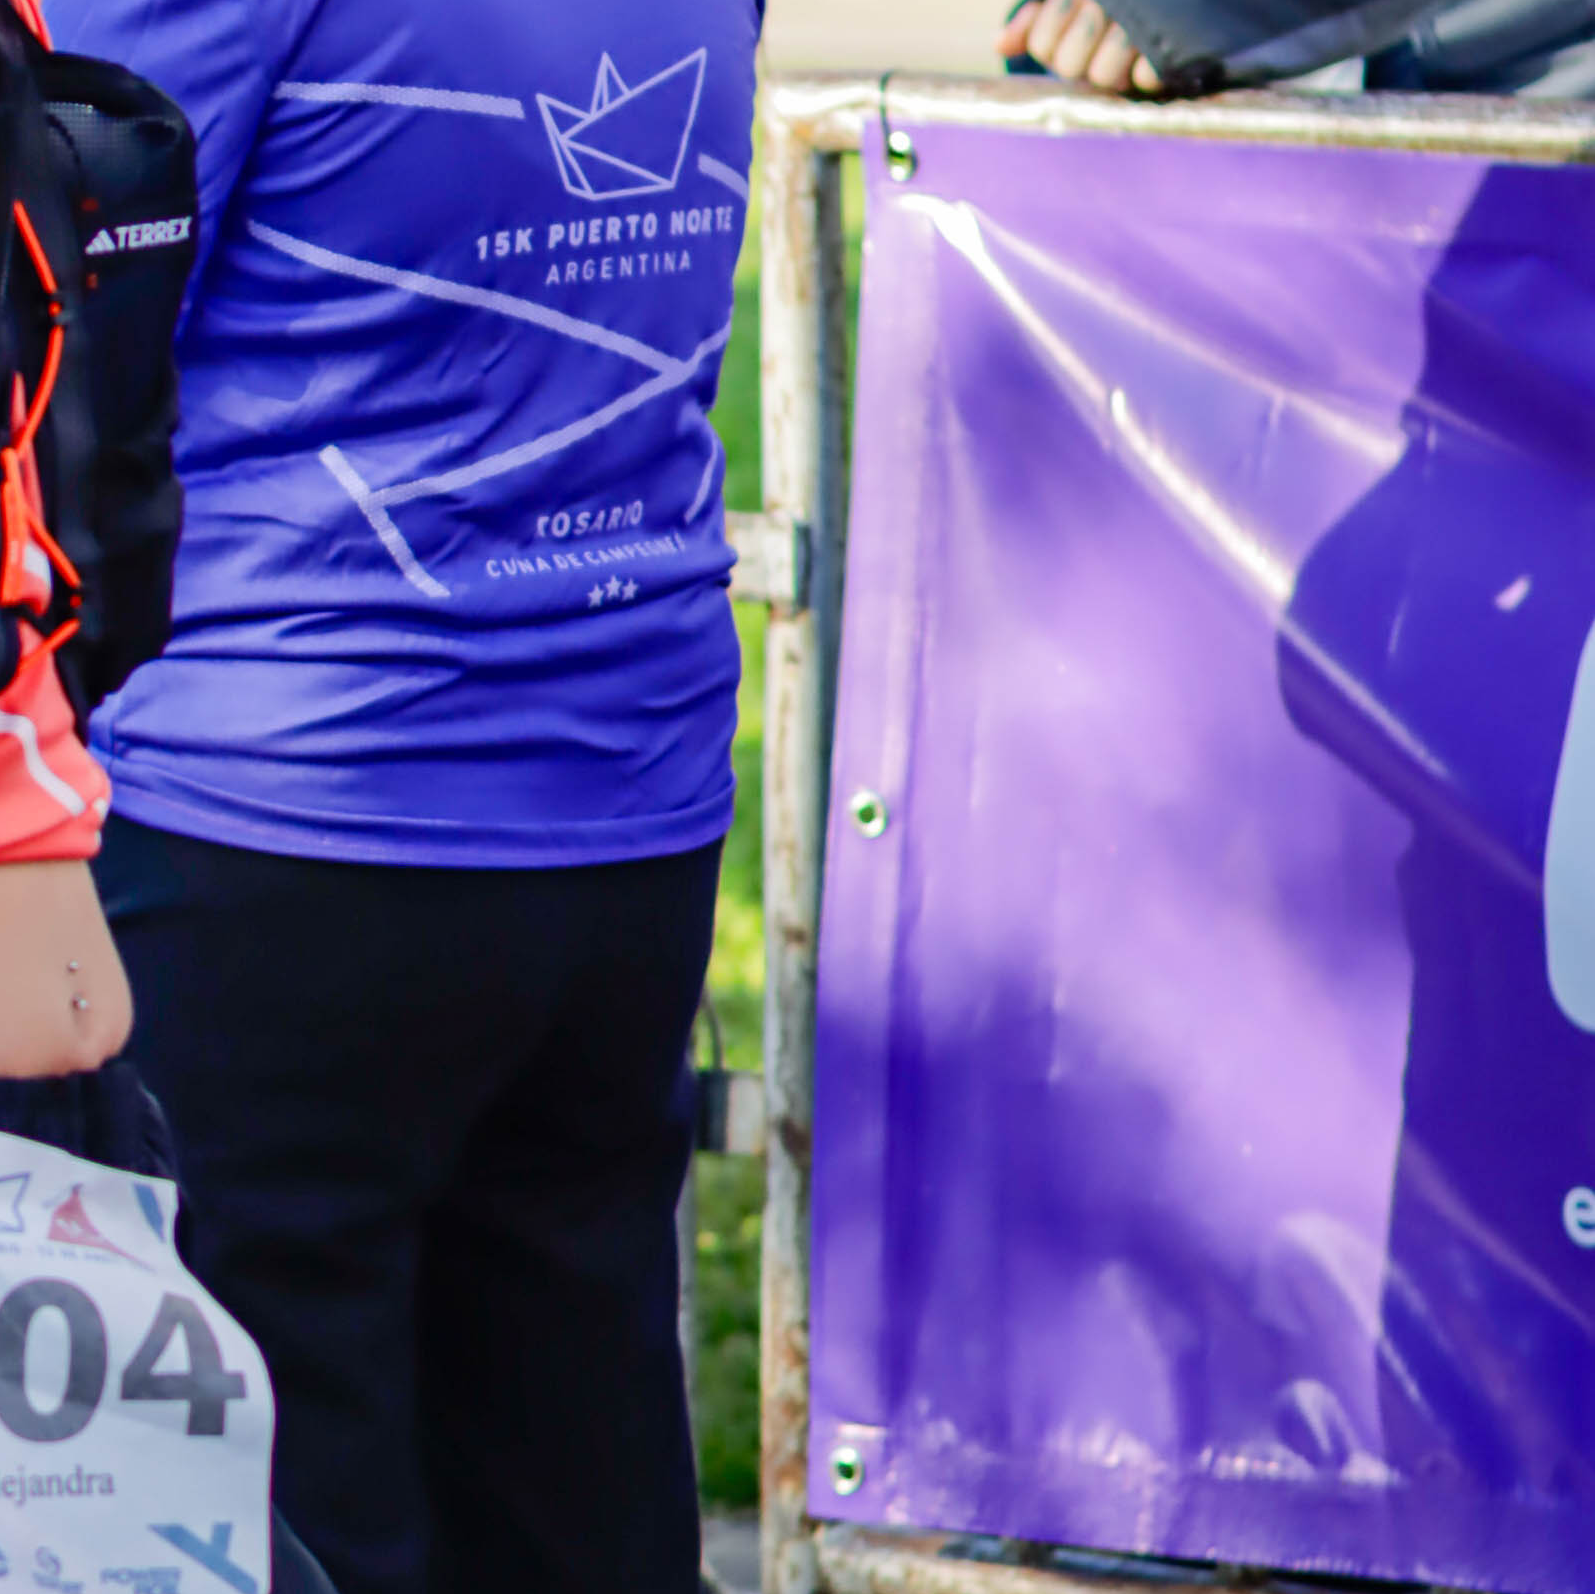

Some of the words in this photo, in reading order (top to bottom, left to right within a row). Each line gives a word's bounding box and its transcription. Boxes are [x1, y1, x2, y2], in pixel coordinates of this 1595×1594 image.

[115, 216, 193, 251] TERREX
[476, 227, 533, 261] 15K
[548, 212, 658, 250] PUERTO
[670, 205, 733, 236] NORTE
[545, 249, 691, 286] ARGENTINA
[486, 556, 551, 578] CUNA
[553, 552, 584, 571] DE
